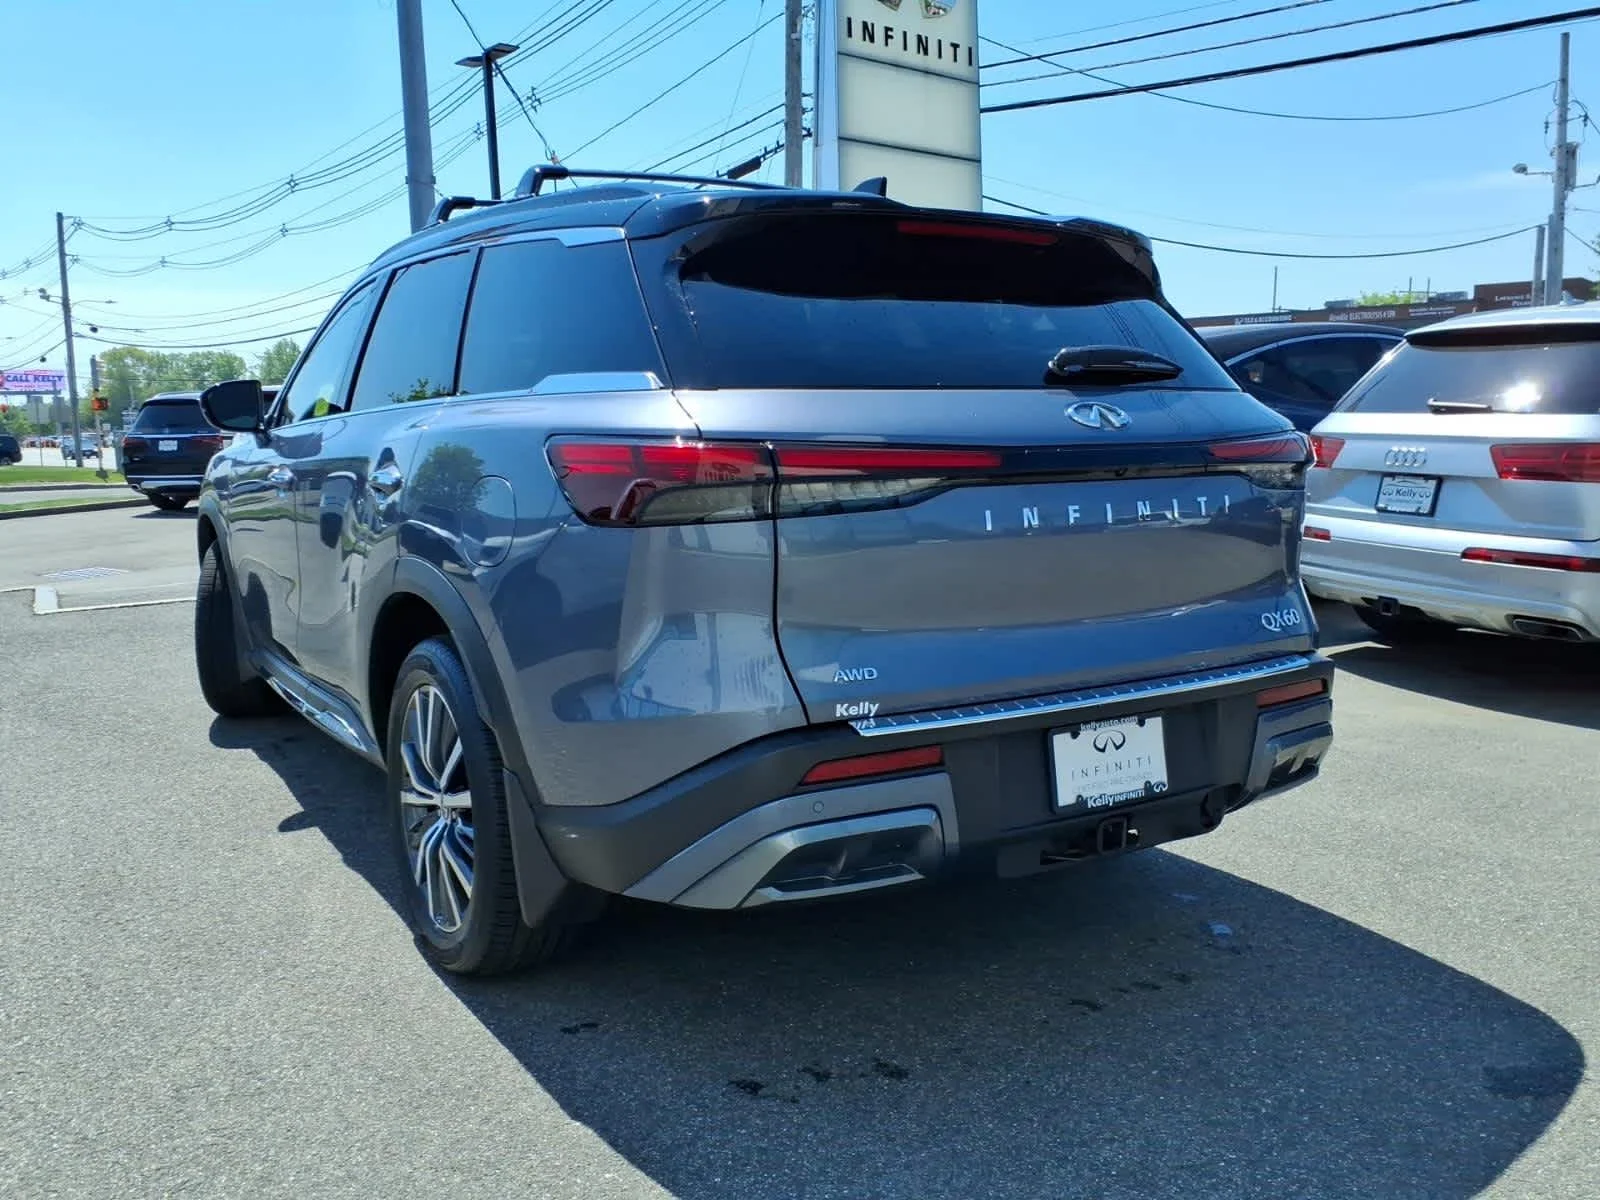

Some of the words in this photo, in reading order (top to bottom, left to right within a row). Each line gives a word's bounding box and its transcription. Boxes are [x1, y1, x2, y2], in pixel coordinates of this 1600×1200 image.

[847, 16, 973, 66] INFINITI
[1395, 487, 1417, 499] Kelly
[984, 495, 1230, 531] INFINITI
[1261, 608, 1300, 632] QX60
[834, 667, 878, 682] AWD
[836, 701, 879, 717] Kelly
[1080, 715, 1138, 731] kellyauto.com
[1071, 755, 1152, 779] INFINITI
